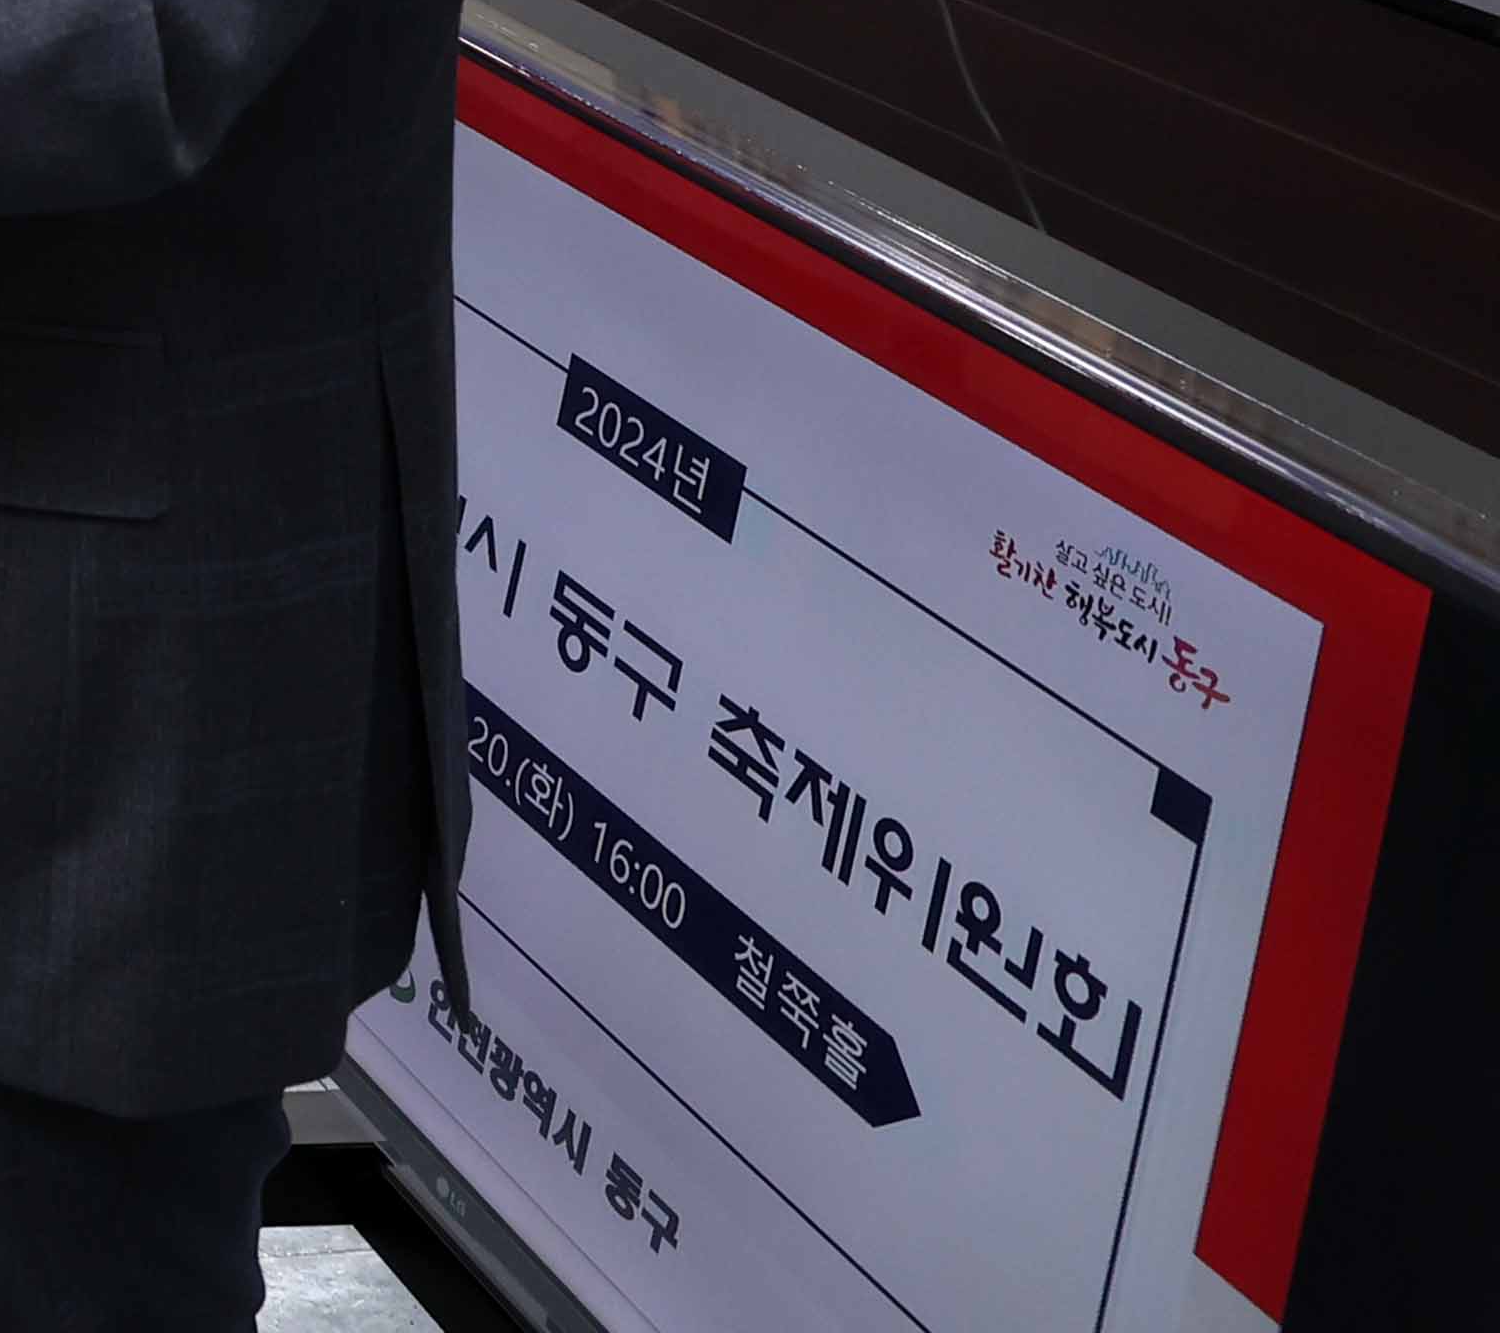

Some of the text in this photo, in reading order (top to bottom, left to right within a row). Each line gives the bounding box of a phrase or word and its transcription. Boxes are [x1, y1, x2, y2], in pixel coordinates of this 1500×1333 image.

[574, 386, 710, 515] 2024년
[989, 529, 1231, 710] 활기찬 행복도시 동구
[1055, 539, 1173, 627] 살고 싶은 도시!
[549, 569, 684, 722] 동구
[708, 693, 1143, 1101] 축제위원회
[593, 821, 687, 930] 16:00
[733, 934, 870, 1090] 철쭉홀
[604, 1151, 681, 1255] 동구
